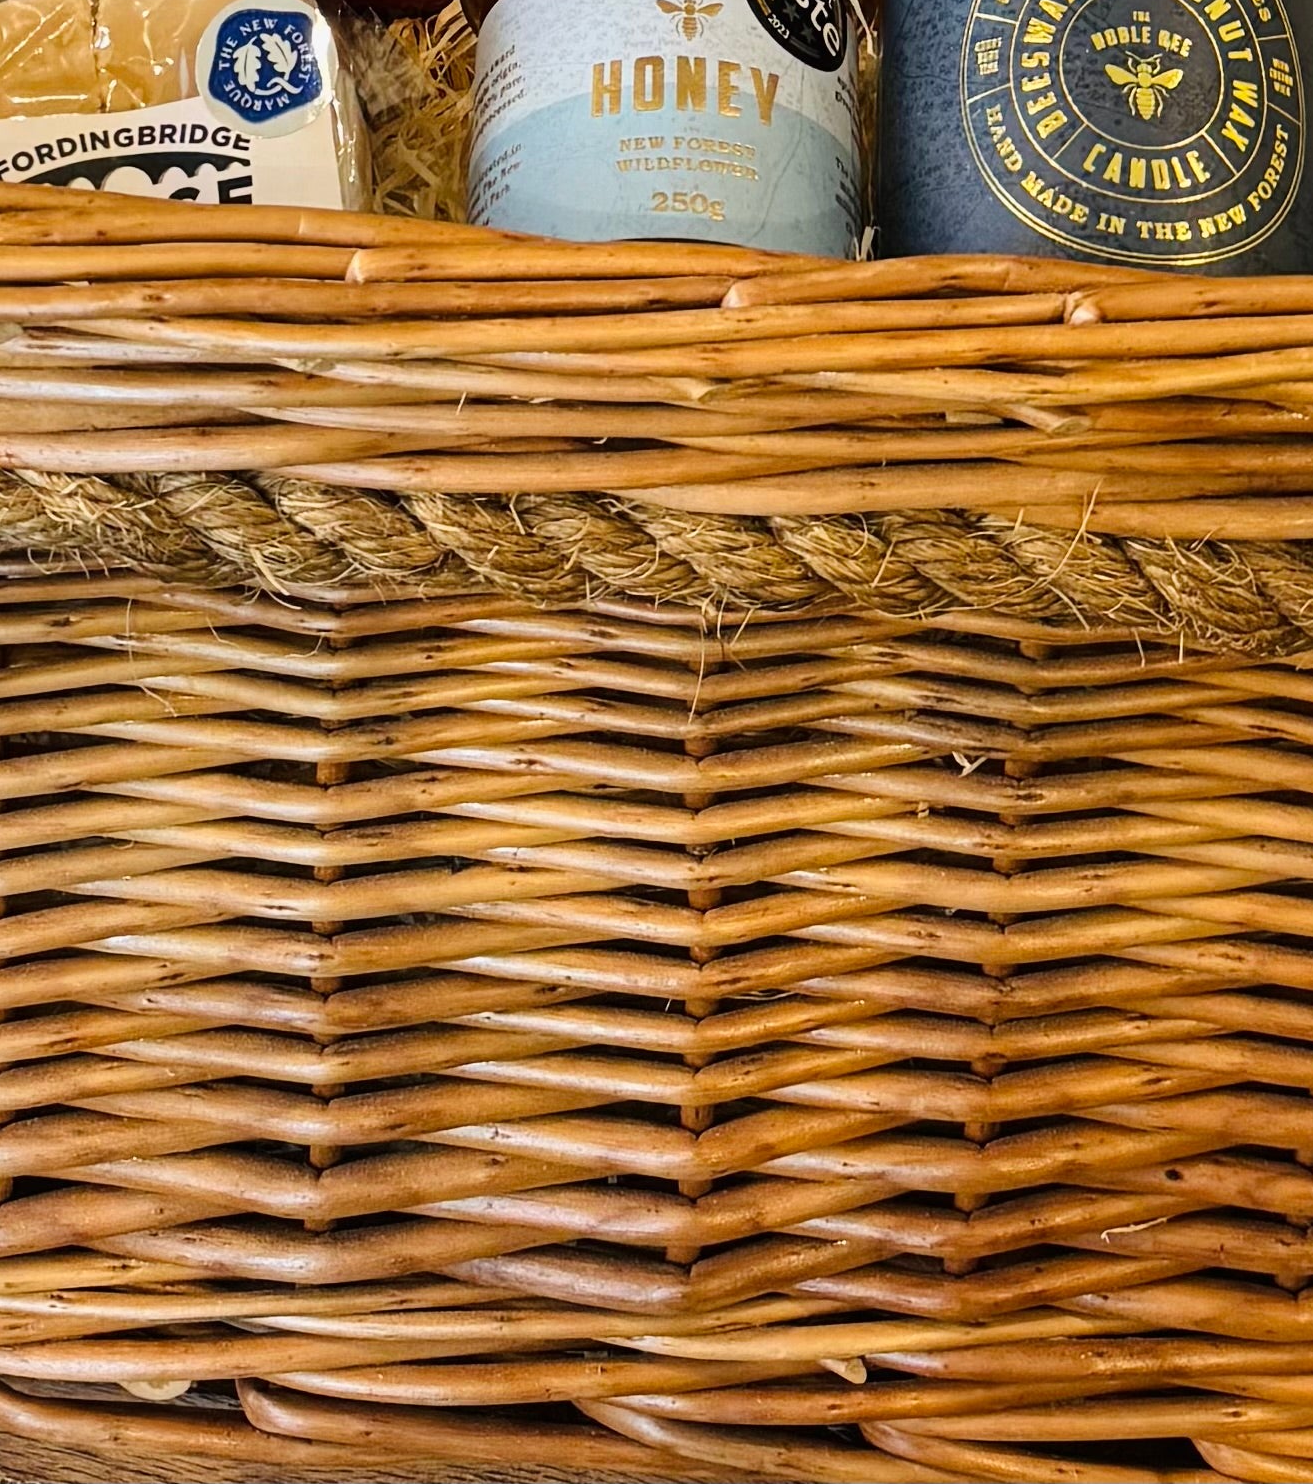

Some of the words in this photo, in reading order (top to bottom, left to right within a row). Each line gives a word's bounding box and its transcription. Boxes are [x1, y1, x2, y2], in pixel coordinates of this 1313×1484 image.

[591, 55, 779, 127] HONEY
[619, 136, 666, 152] NEW
[672, 136, 756, 160] FOREST
[616, 157, 759, 181] WILDFLOWER
[1083, 143, 1211, 191] CANDLE
[651, 193, 726, 221] 250g
